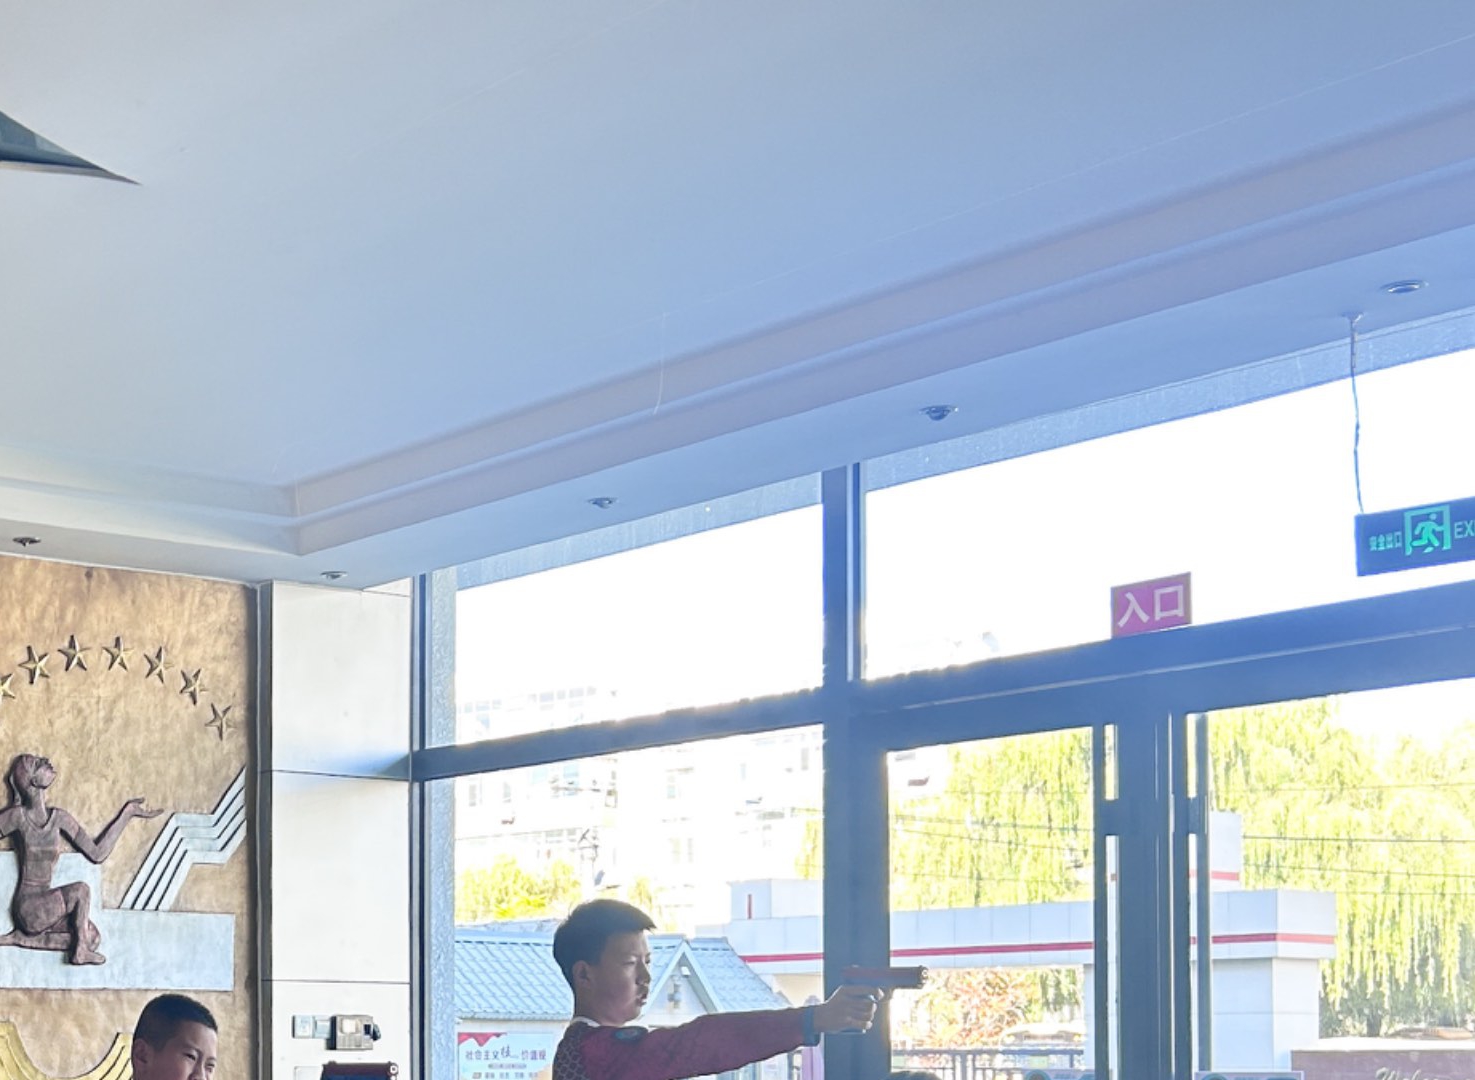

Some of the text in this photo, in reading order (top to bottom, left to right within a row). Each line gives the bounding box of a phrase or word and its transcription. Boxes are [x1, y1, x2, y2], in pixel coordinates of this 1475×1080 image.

[1454, 519, 1475, 539] EX
[1368, 531, 1402, 552] 安全出口
[1117, 584, 1185, 628] 入口
